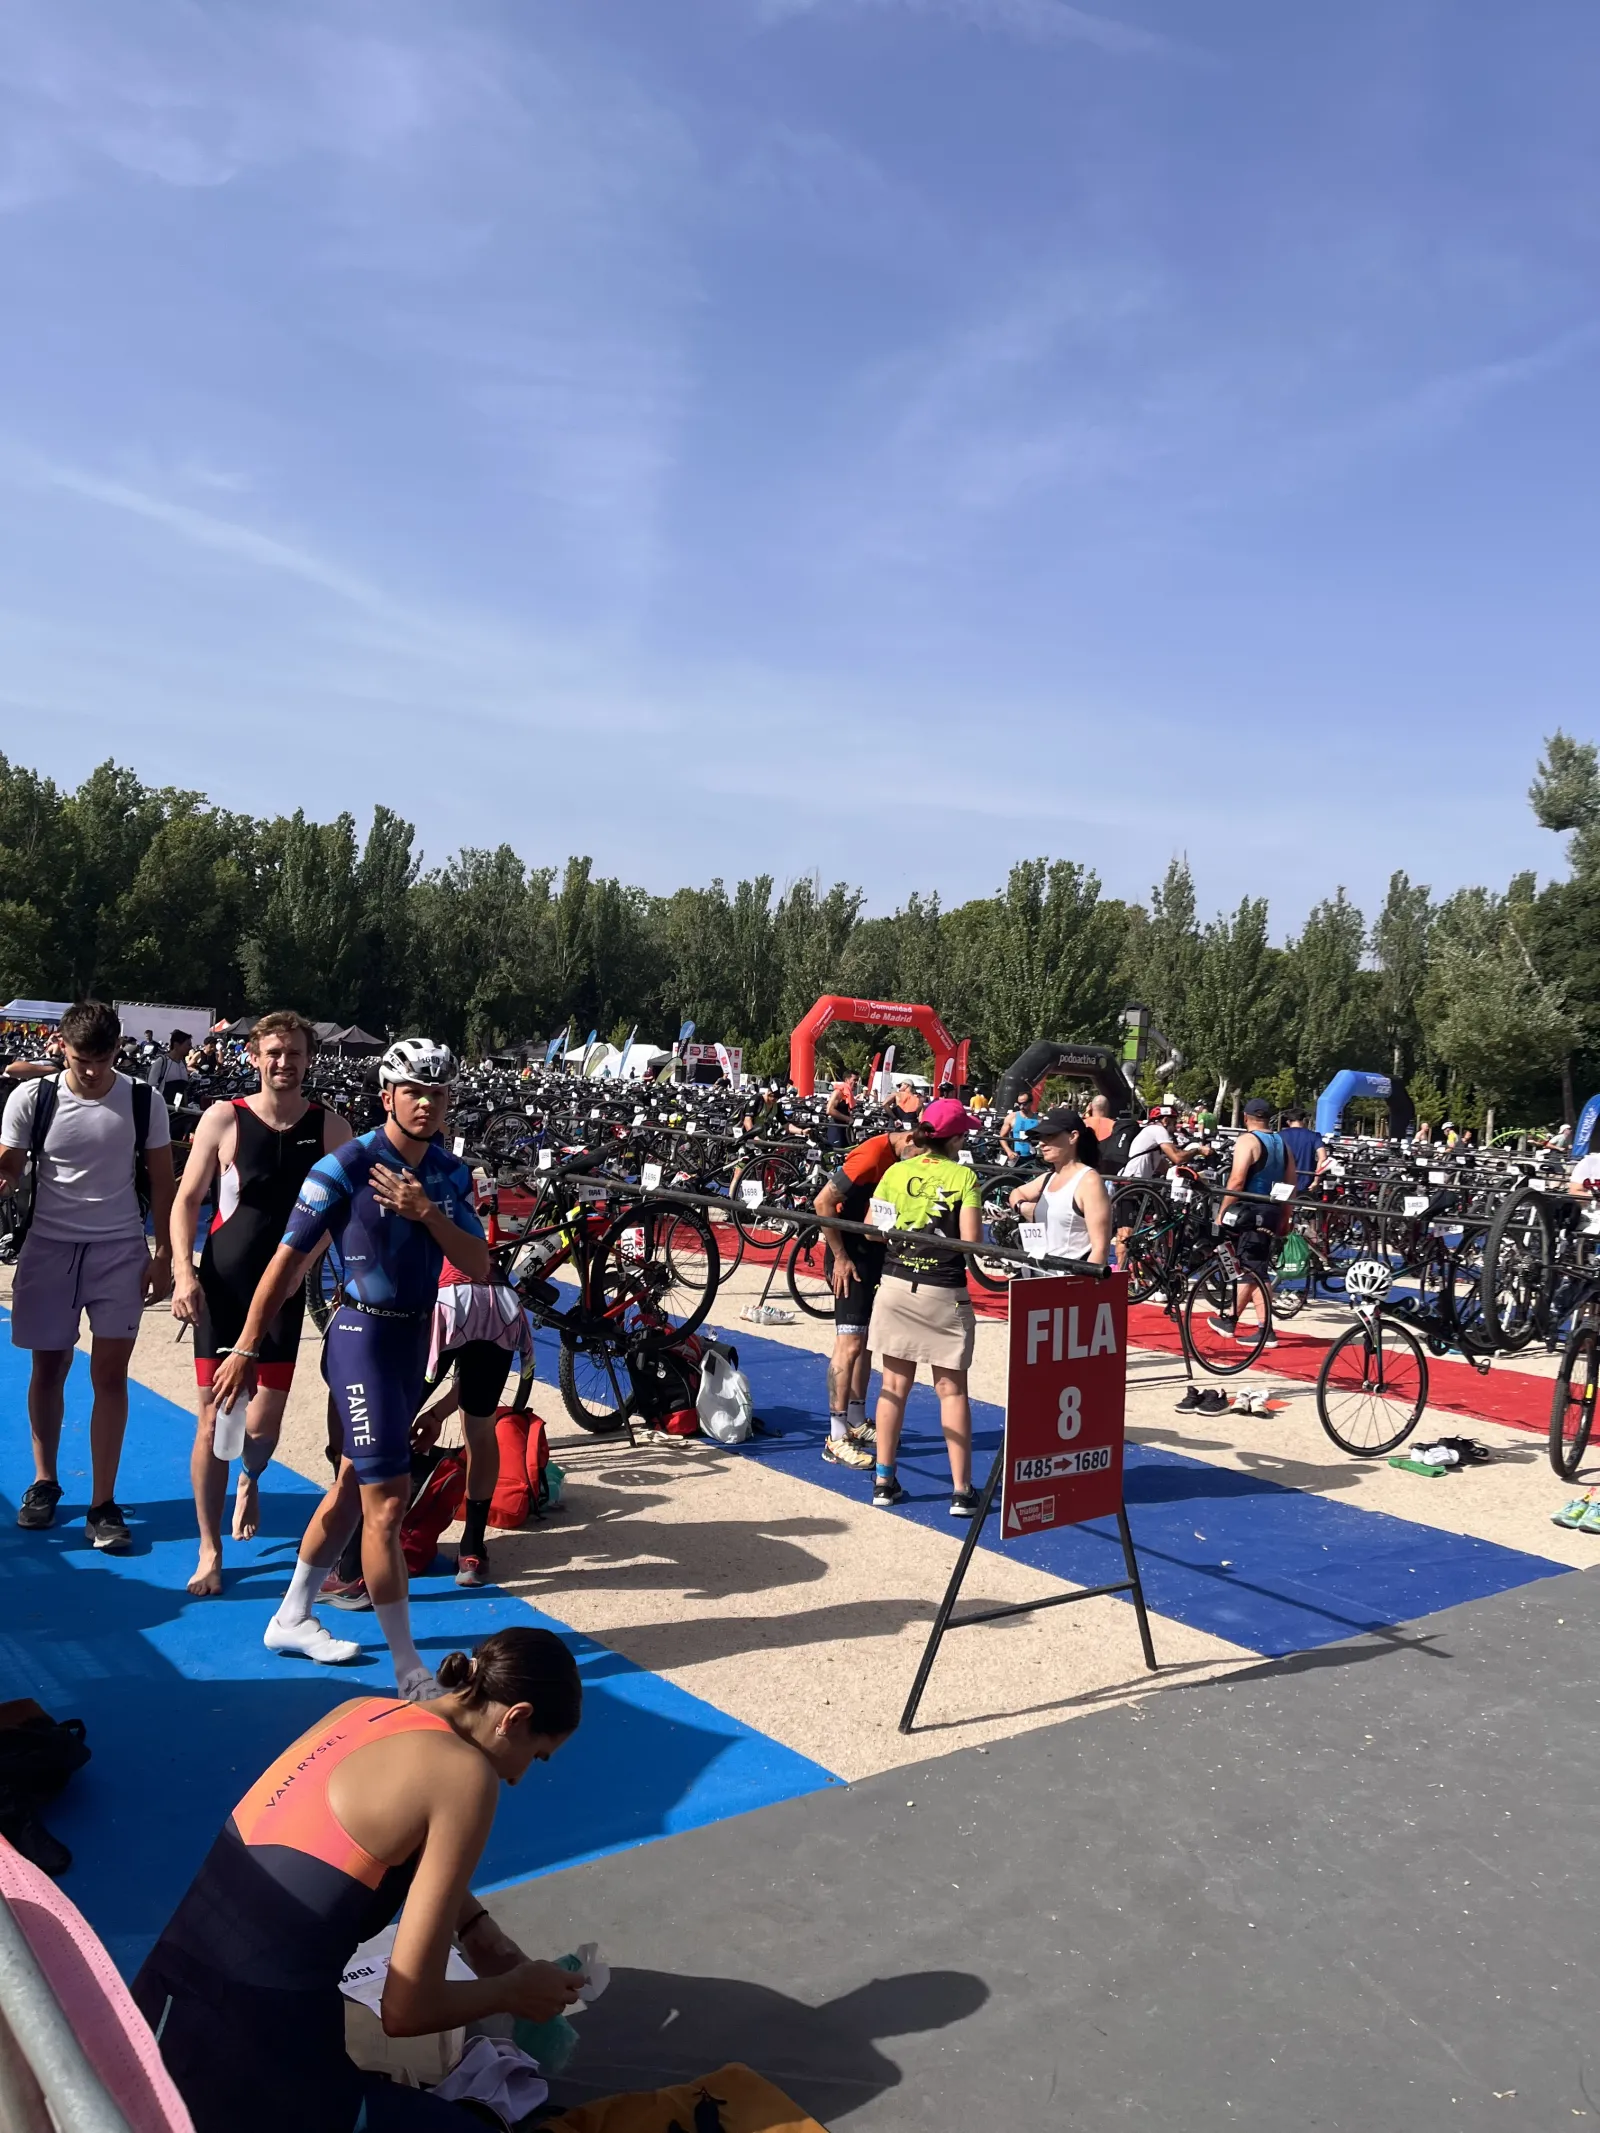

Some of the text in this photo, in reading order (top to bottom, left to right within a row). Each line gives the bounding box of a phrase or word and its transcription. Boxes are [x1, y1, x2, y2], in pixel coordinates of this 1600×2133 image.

[870, 1002, 913, 1013] Comunidad
[870, 1012, 913, 1023] de Madrid
[1058, 1052, 1097, 1067] podoactiva
[743, 1188, 758, 1197] 1698
[295, 1202, 317, 1217] FANTÉ
[1023, 1228, 1042, 1239] 1702
[338, 1324, 363, 1332] MUUR
[1026, 1302, 1117, 1365] FILA
[346, 1383, 376, 1446] FANTÉ
[1057, 1386, 1082, 1441] 8
[1016, 1449, 1109, 1480] 1485 1680
[1022, 1513, 1042, 1523] madrid
[265, 1732, 348, 1808] VAN RYSEL
